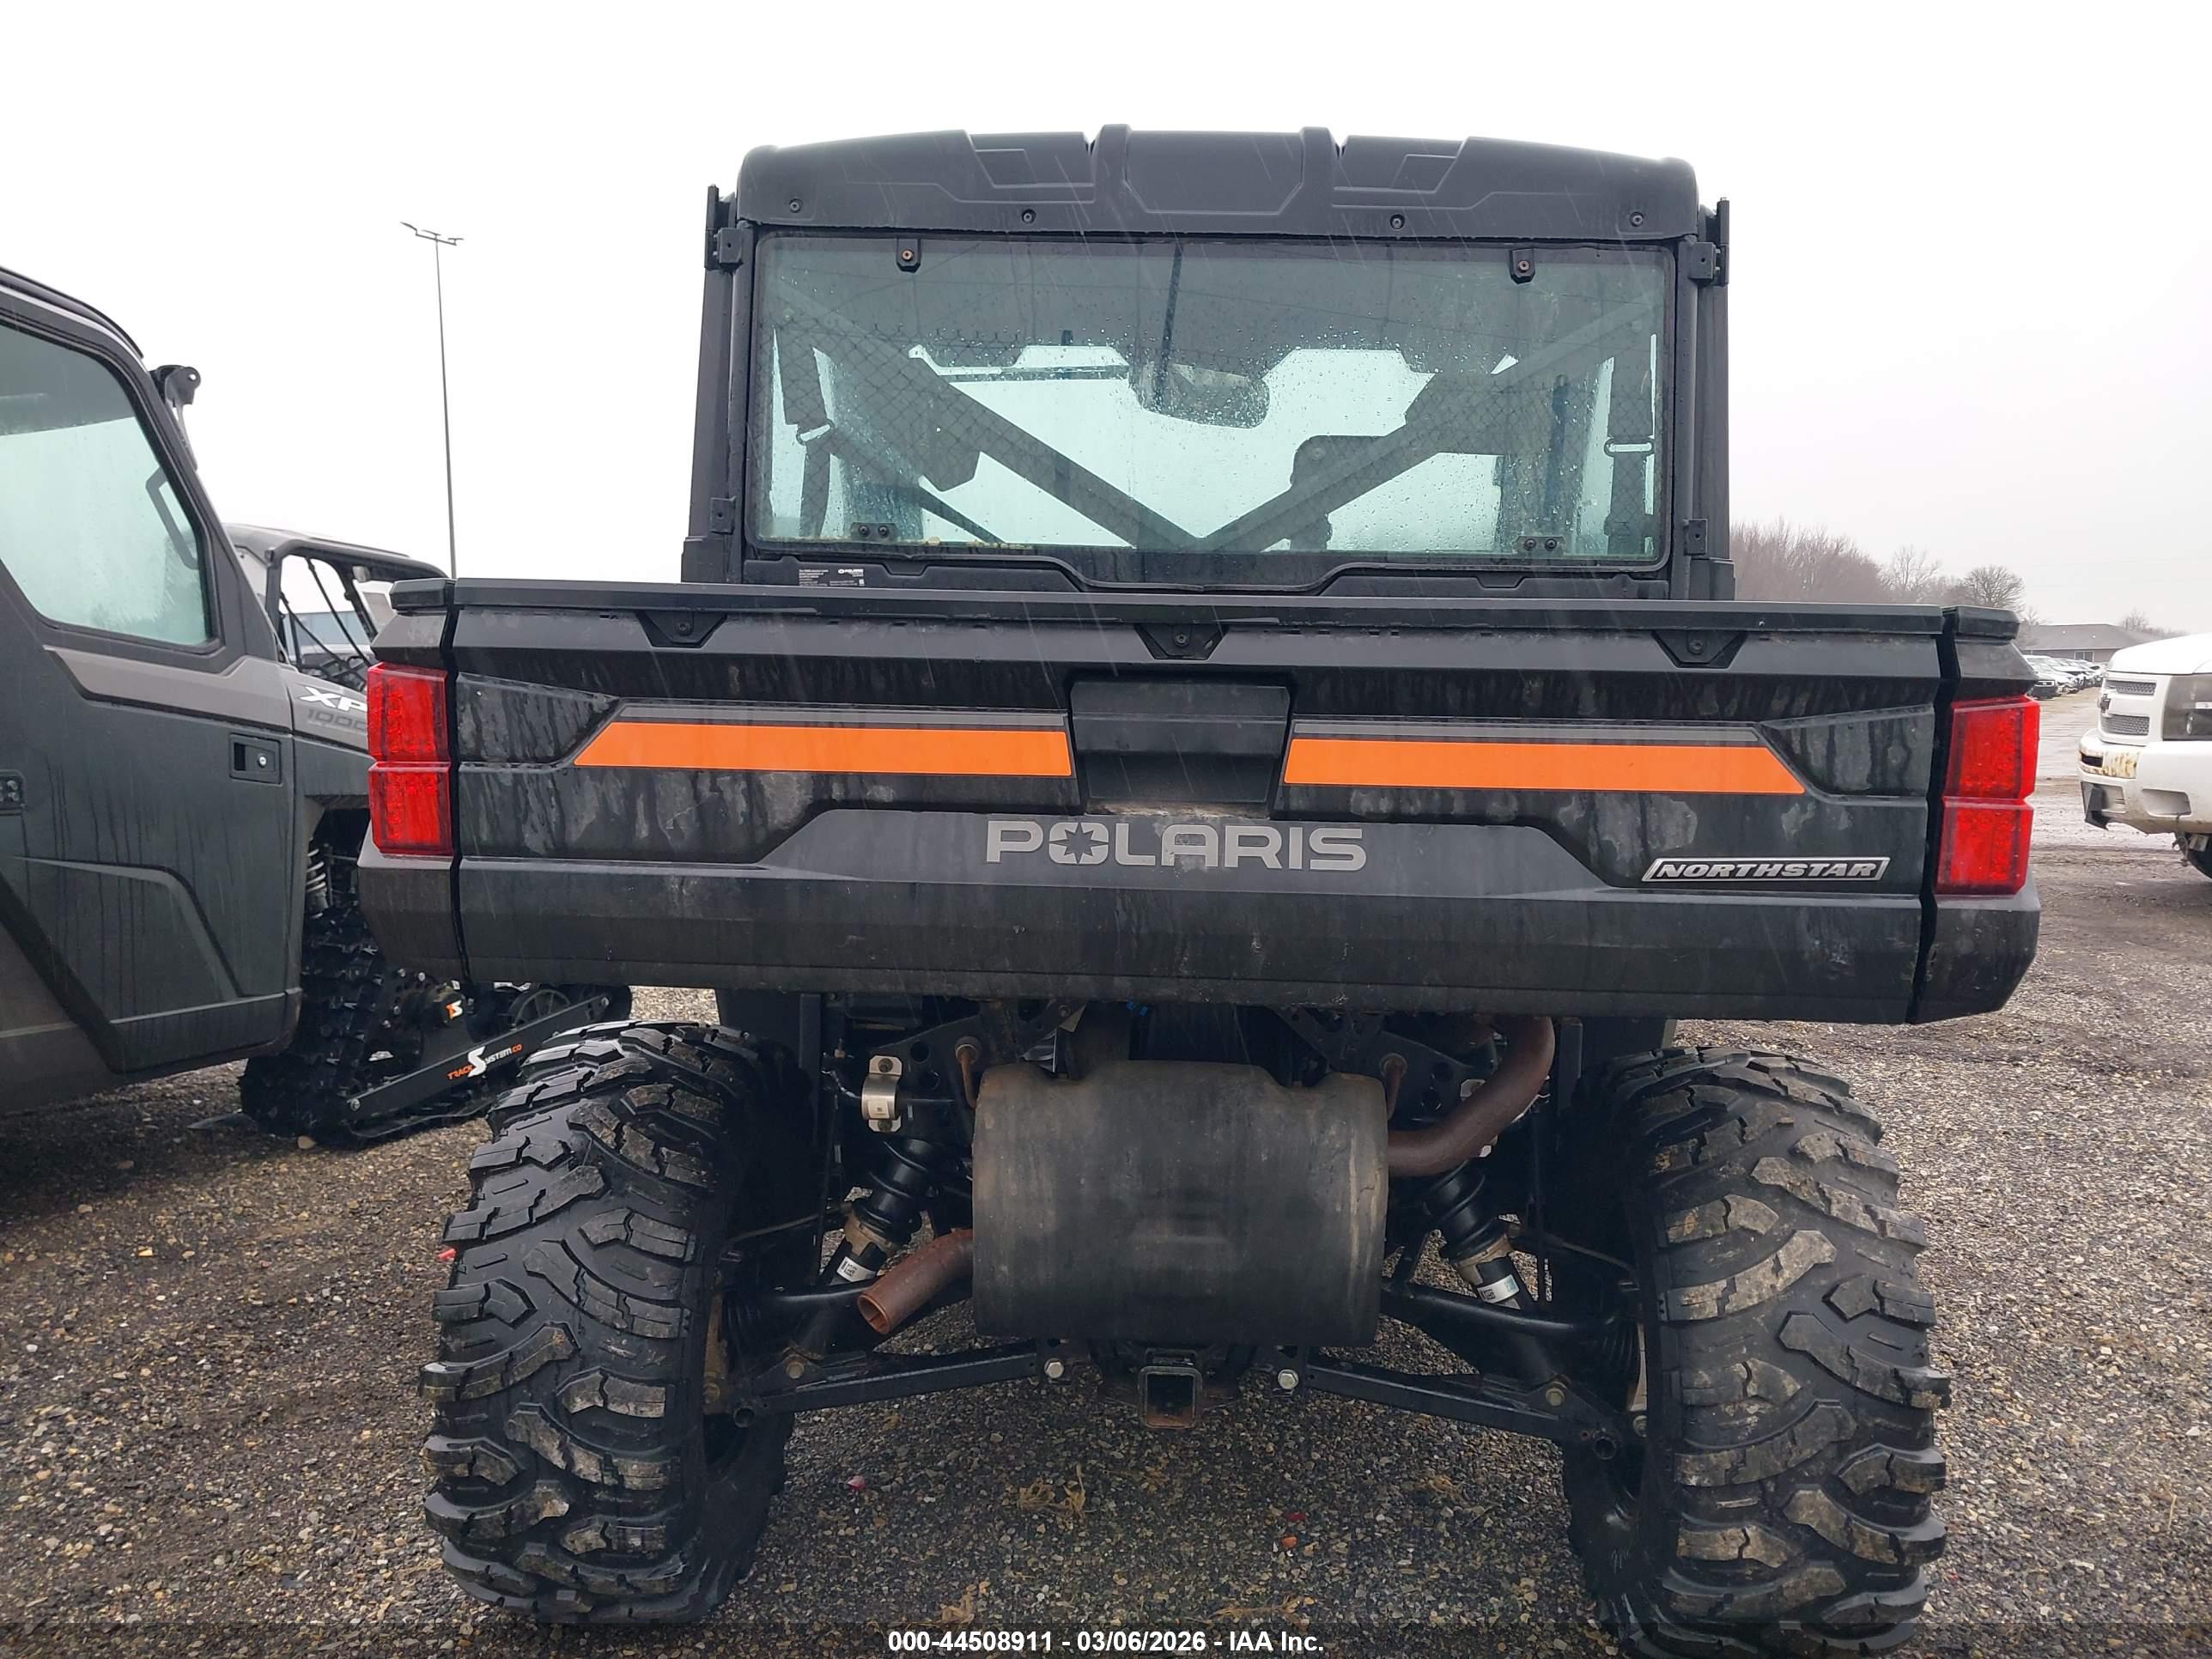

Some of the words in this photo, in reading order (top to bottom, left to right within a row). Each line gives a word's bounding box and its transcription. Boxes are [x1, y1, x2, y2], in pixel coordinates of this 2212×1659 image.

[300, 686, 368, 712] XP
[986, 819, 1367, 872] POLARIS
[1656, 862, 1877, 878] NORTHSTAR
